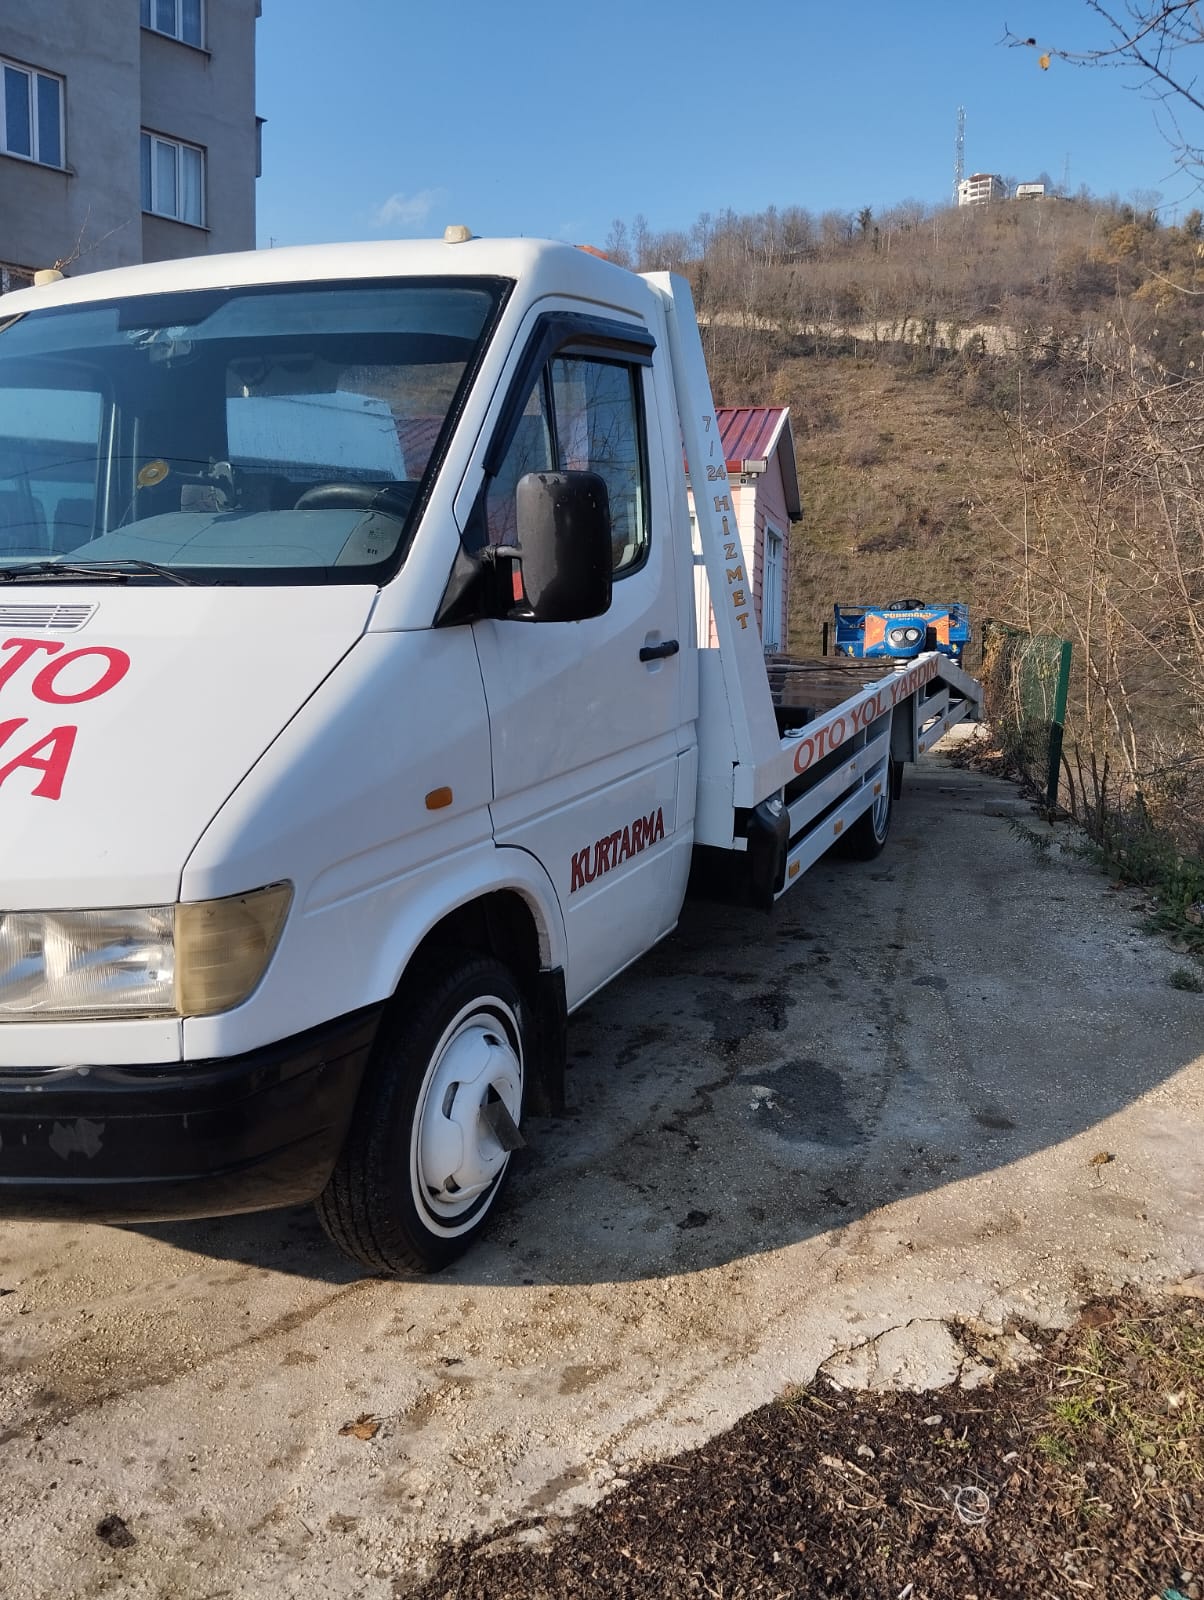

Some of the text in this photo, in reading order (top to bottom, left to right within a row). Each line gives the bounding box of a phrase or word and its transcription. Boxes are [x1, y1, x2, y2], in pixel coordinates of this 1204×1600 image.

[793, 657, 939, 774] OTO YOL YARDIM
[570, 806, 665, 894] KURTARMA
